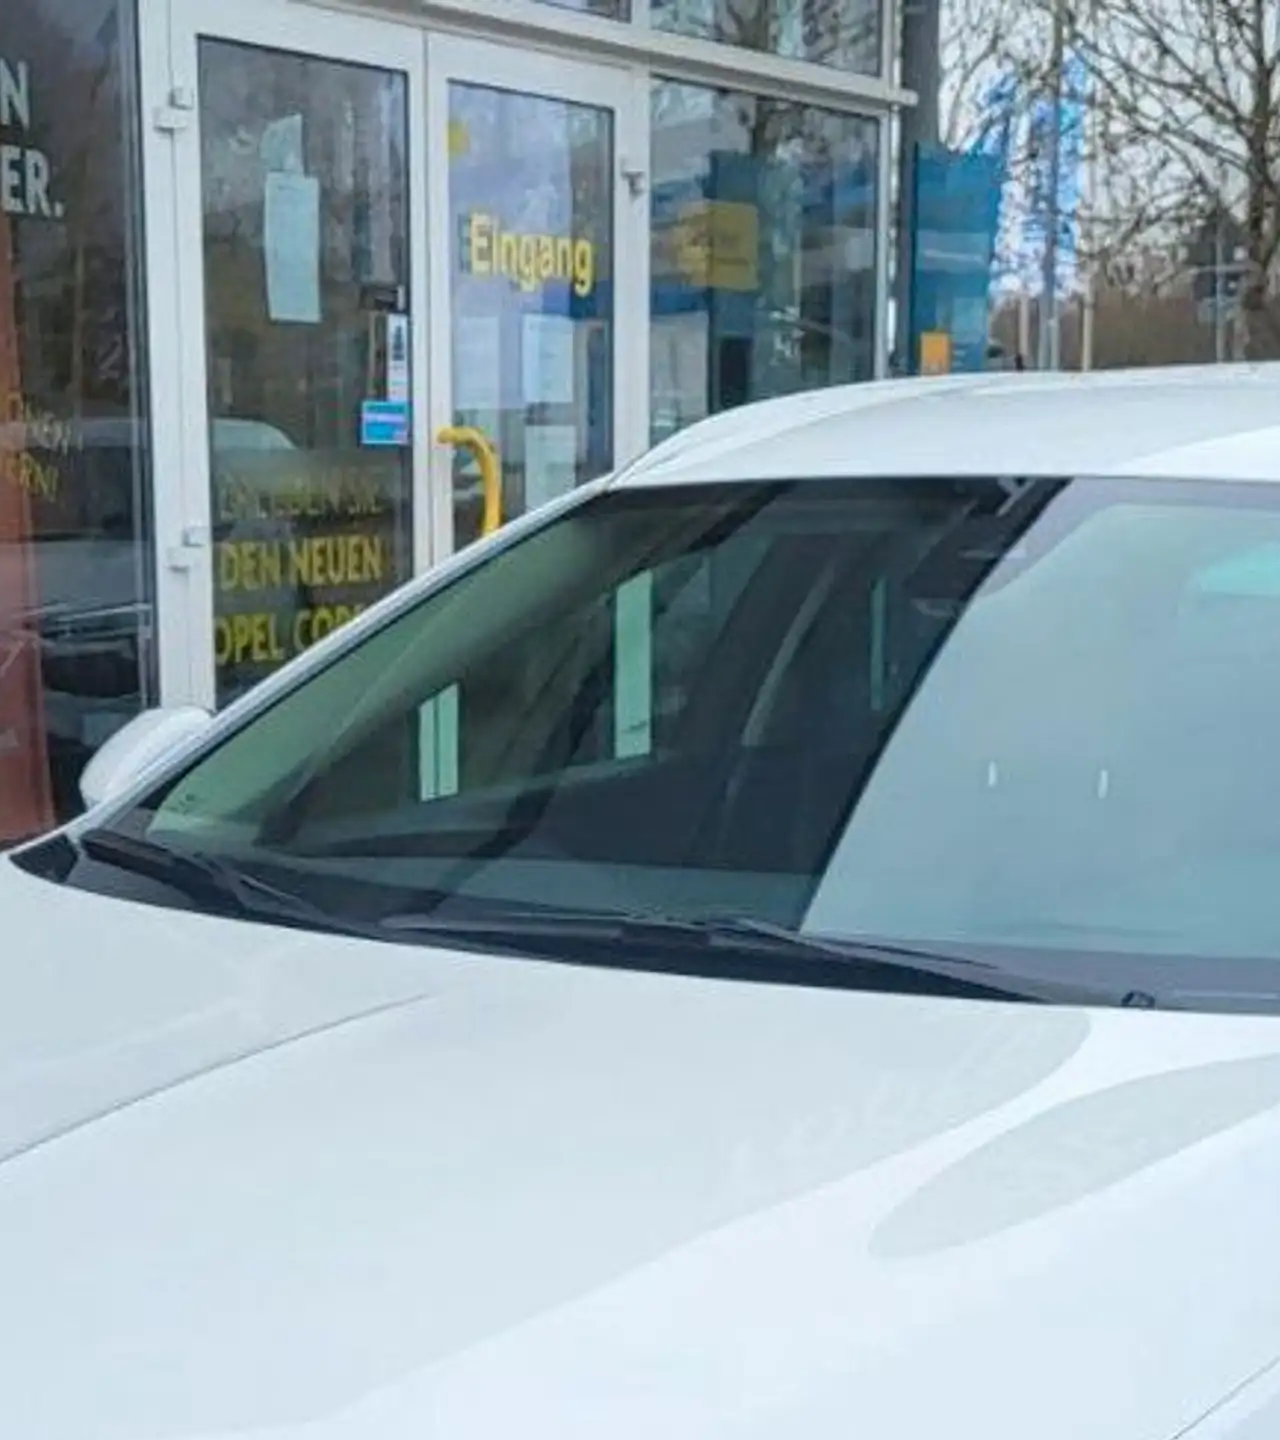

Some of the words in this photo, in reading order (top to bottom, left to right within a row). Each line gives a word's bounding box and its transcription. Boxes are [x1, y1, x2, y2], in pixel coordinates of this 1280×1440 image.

[470, 212, 593, 297] Eingang
[219, 540, 282, 591] DEN
[290, 534, 383, 587] NEUEN
[214, 613, 284, 664] OPEL
